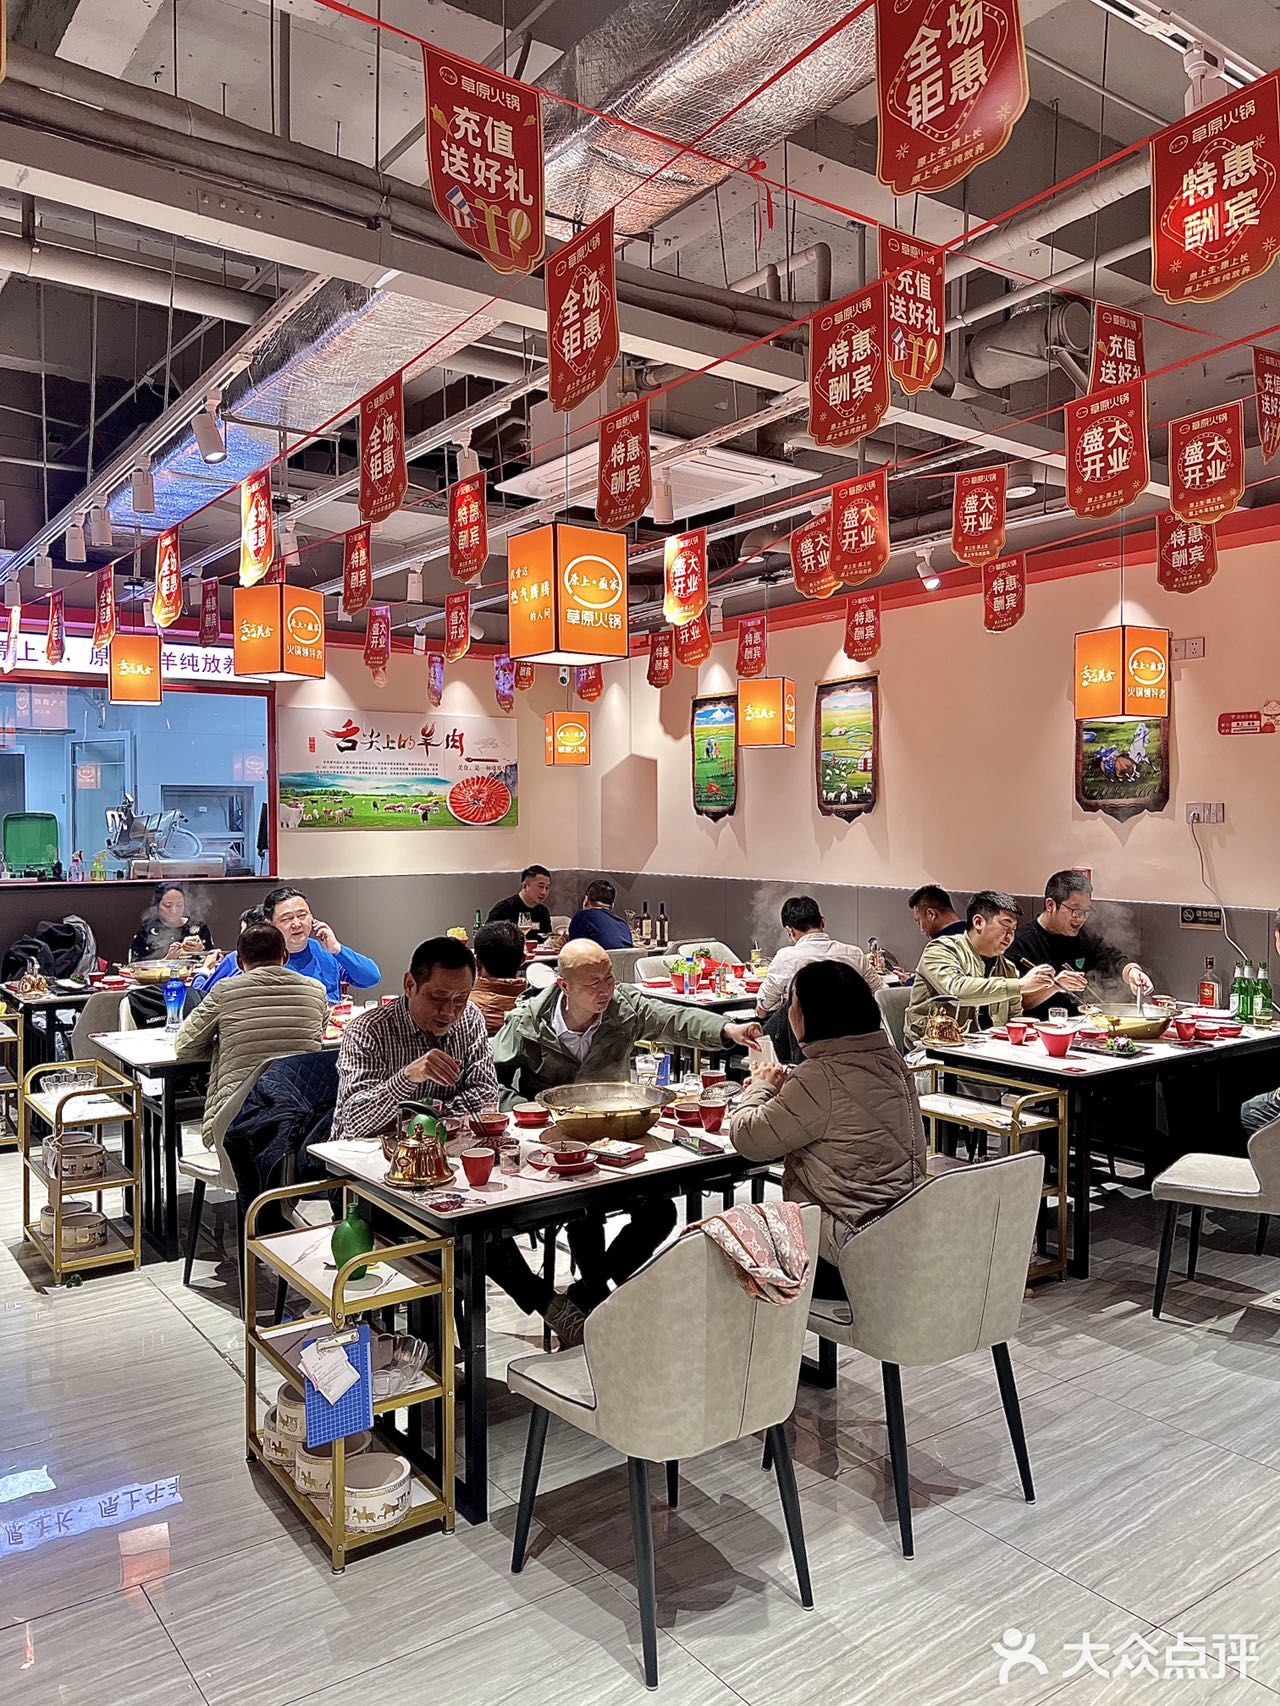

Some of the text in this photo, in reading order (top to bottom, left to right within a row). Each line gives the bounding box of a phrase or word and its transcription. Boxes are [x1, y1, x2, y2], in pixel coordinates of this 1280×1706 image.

[904, 0, 985, 82] 全场
[461, 75, 520, 112] 草原火锅
[906, 41, 988, 130] 钜惠
[453, 105, 514, 159] 充值
[1192, 100, 1255, 144] 草原火锅
[440, 140, 534, 207] 送好礼
[1182, 141, 1258, 207] 特惠
[1183, 188, 1261, 251] 酬宾
[567, 232, 601, 269] 草原火锅
[561, 270, 600, 327] 全场
[834, 297, 872, 325] 草原火锅
[889, 293, 940, 335] 送好礼
[562, 308, 602, 363] 钜惠
[1109, 334, 1137, 361] 充值
[828, 331, 872, 372] 特惠
[828, 363, 873, 406] 酬宾
[1090, 393, 1130, 415] 草原火锅
[1261, 394, 1280, 418] 送好
[615, 410, 640, 429] 草原火锅
[1192, 413, 1228, 430] 草原火锅
[369, 415, 394, 454] 全场
[1083, 420, 1130, 455] 盛大
[369, 446, 395, 482] 钜惠
[611, 435, 641, 468] 特惠
[1083, 448, 1130, 482] 开业
[1184, 436, 1228, 466] 盛大
[610, 465, 641, 496] 酬宾
[848, 481, 876, 496] 草原火锅
[1184, 460, 1227, 489] 开业
[843, 504, 877, 531] 盛大
[964, 492, 994, 514] 盛大
[963, 512, 993, 534] 开业
[1170, 525, 1203, 548] 特惠
[801, 534, 829, 557] 盛大
[841, 525, 877, 552] 开业
[673, 555, 699, 578] 盛大
[801, 549, 830, 574] 开业
[1171, 545, 1205, 568] 酬宾
[673, 574, 699, 597] 开业
[993, 575, 1017, 595] 特惠
[566, 609, 622, 630] 草原火锅
[854, 609, 875, 625] 特惠
[680, 625, 702, 645] 开业
[579, 666, 596, 682] 开业
[322, 718, 465, 758] 舌尖上的羊肉
